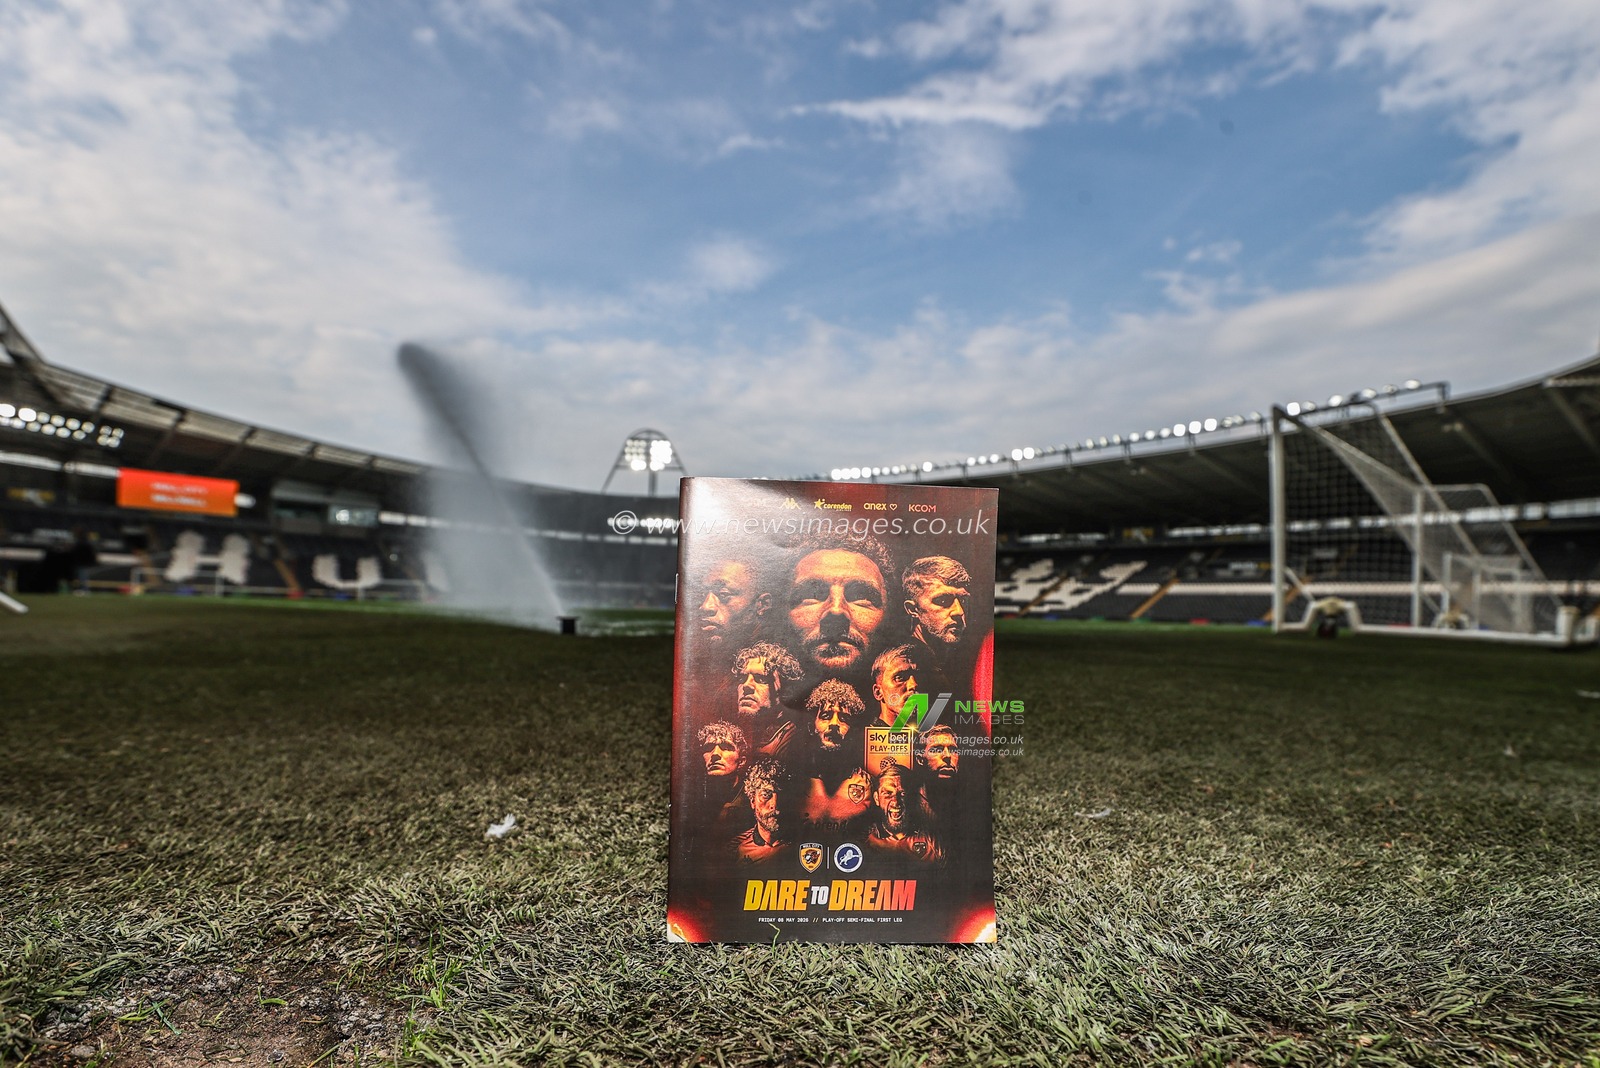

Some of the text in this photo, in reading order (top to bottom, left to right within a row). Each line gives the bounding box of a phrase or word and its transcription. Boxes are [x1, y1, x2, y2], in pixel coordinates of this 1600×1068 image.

[863, 502, 887, 511] anex
[908, 504, 937, 513] KCOM
[869, 732, 887, 743] sky
[743, 880, 917, 911] DARE TO DREAM
